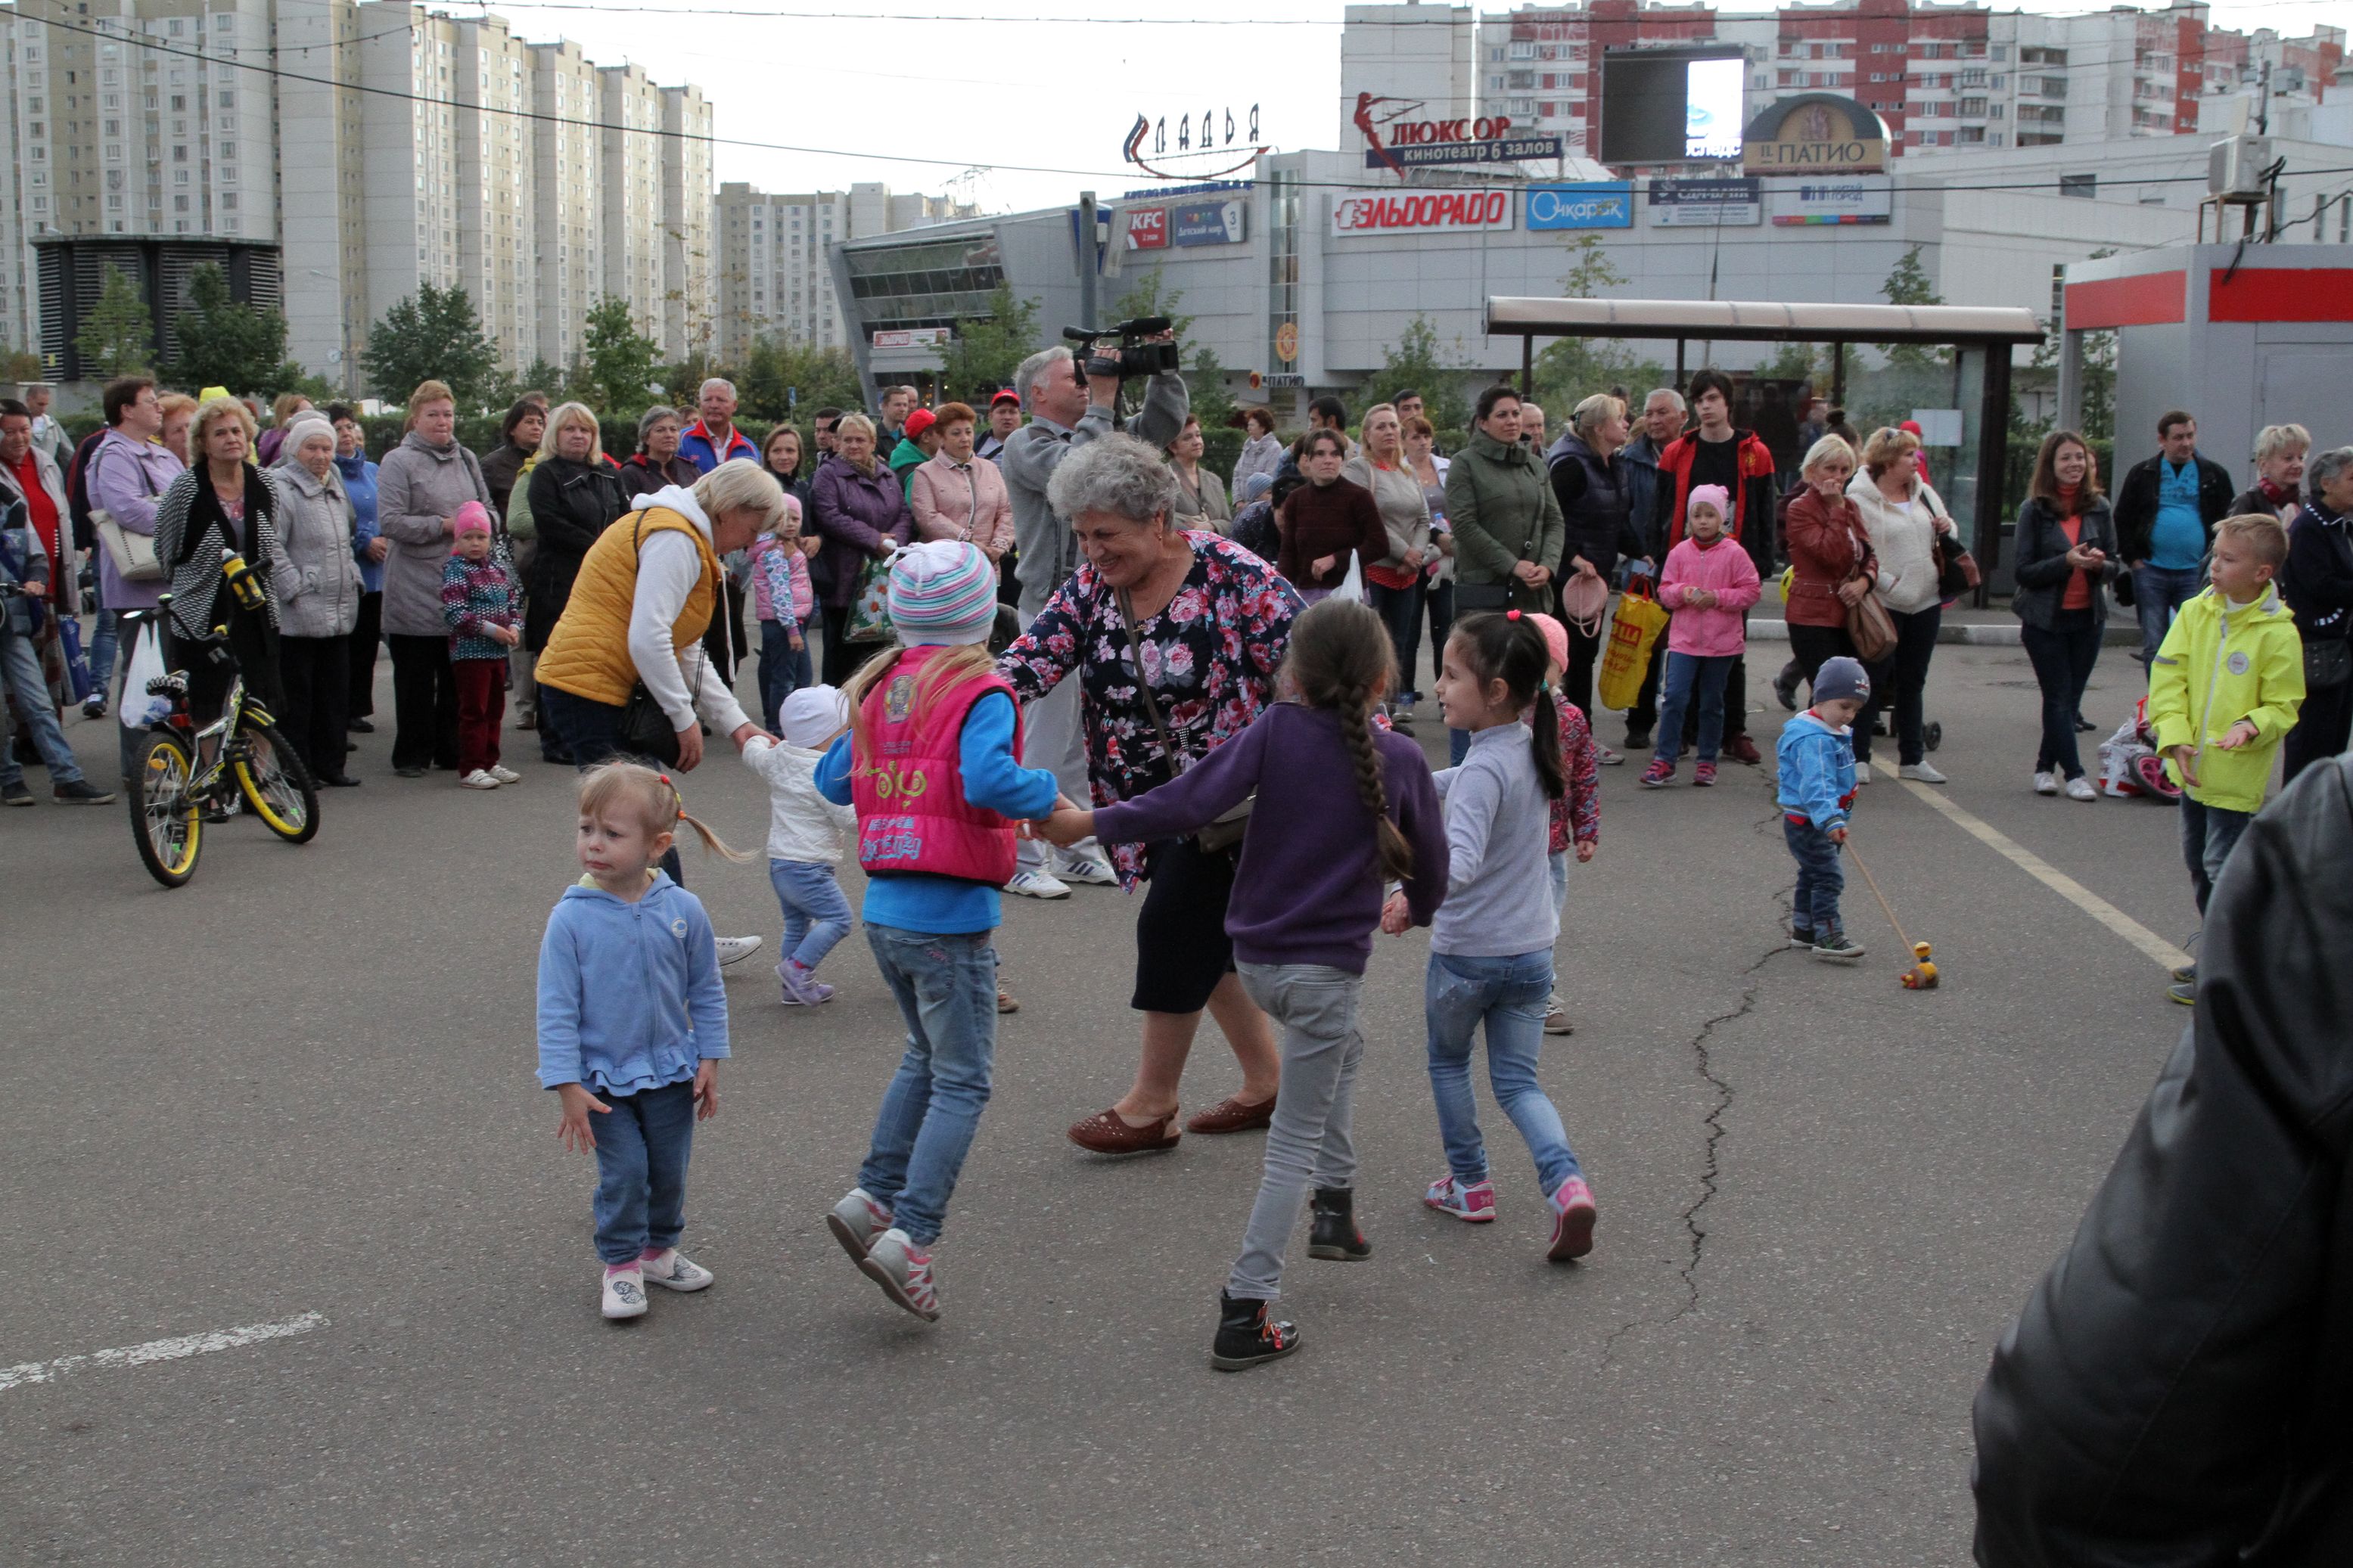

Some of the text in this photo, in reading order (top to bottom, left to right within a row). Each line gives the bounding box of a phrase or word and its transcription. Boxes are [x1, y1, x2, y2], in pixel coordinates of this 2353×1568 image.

[1156, 103, 1260, 153] ЛАДЬЯ
[1390, 116, 1512, 146] ЛЮКСОР
[1403, 141, 1555, 162] кинотеатр 6 залов
[1778, 142, 1865, 163] ПАТИО
[1131, 211, 1162, 230] KFC
[1229, 211, 1236, 225] 3
